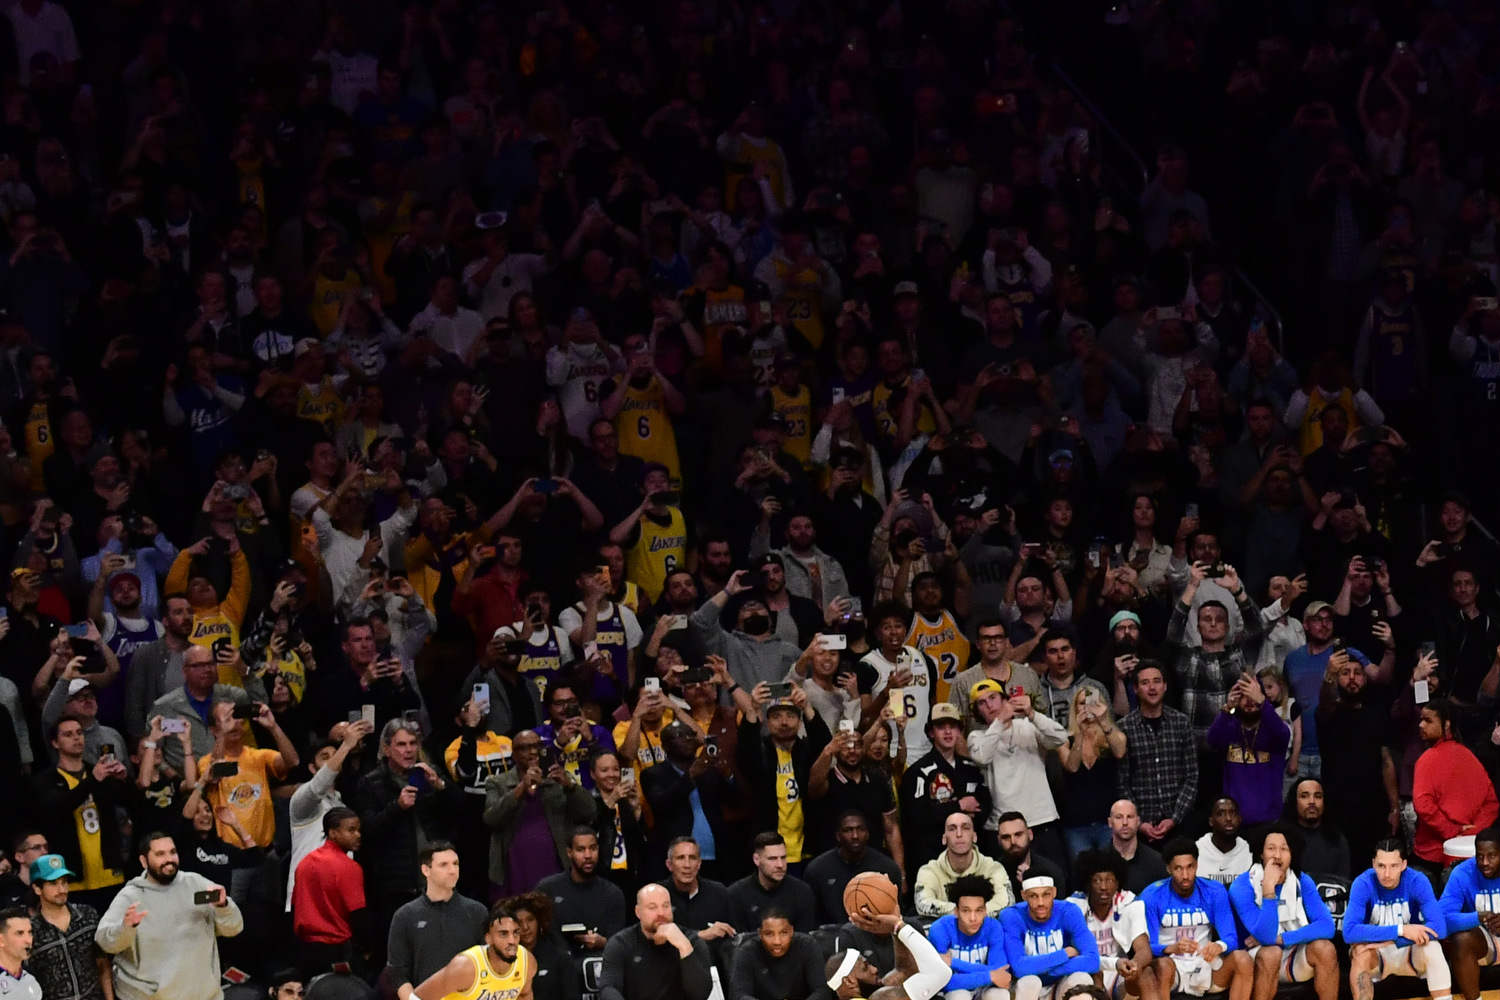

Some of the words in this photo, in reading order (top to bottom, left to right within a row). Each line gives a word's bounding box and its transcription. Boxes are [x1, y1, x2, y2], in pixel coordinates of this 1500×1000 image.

[637, 416, 651, 437] 6
[649, 535, 687, 552] LAKERS
[664, 555, 678, 577] 6
[917, 627, 956, 651] LAKERS
[903, 693, 917, 718] 6
[786, 778, 799, 802] 3
[82, 807, 100, 835] 8
